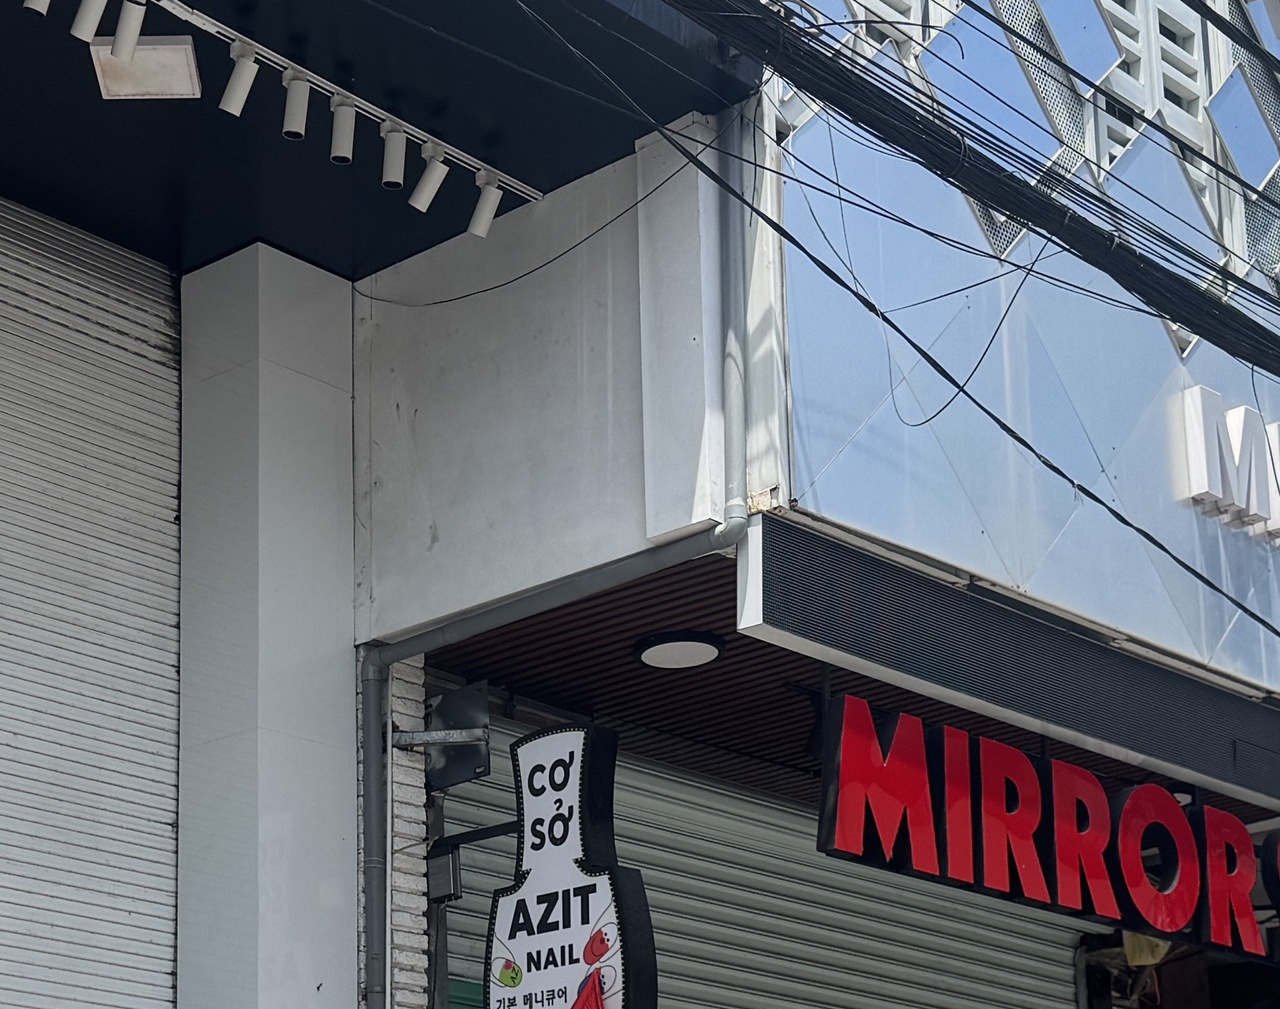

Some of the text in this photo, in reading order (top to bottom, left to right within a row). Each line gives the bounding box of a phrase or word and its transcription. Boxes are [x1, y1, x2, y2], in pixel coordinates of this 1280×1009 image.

[527, 750, 575, 797] CƠ
[530, 798, 574, 851] SỞ
[834, 694, 1267, 957] MIRROR
[508, 883, 597, 940] AZIT
[526, 943, 581, 973] NAIL
[523, 986, 568, 1009] 메니큐어
